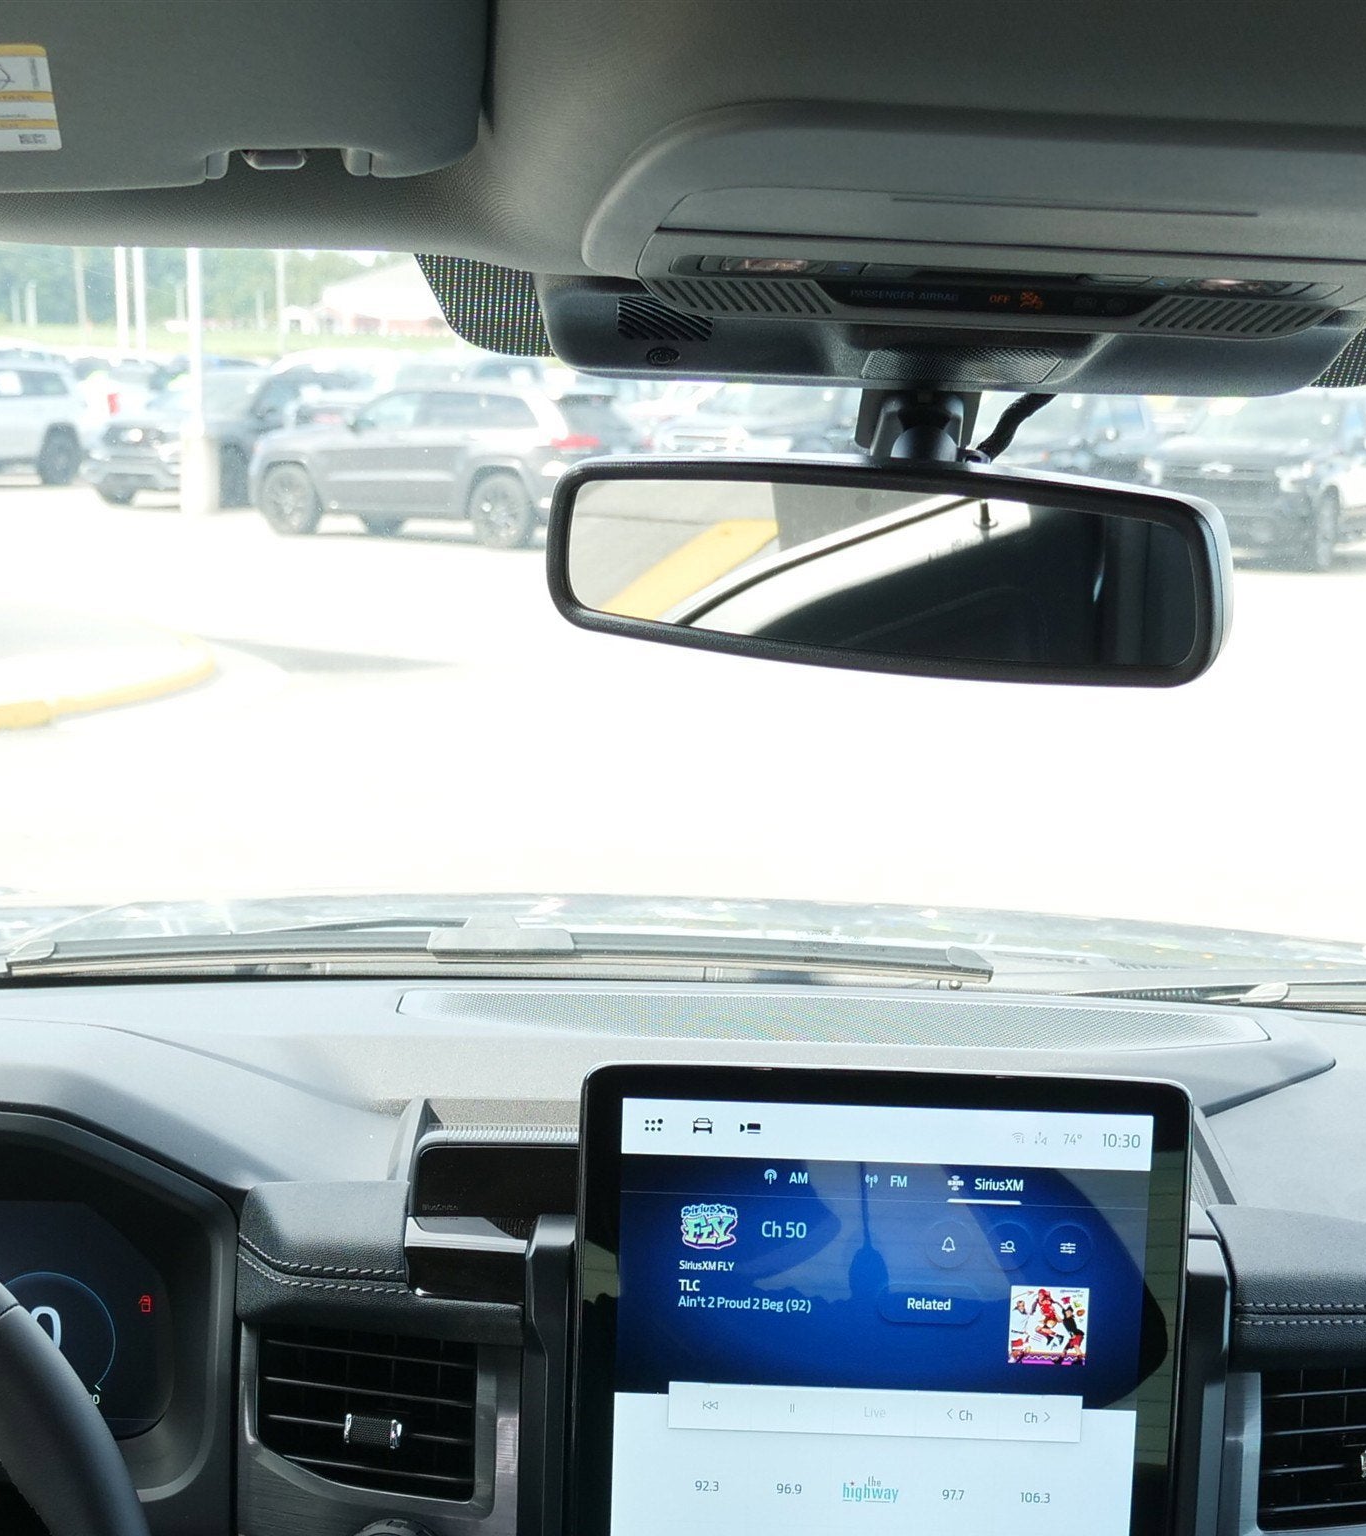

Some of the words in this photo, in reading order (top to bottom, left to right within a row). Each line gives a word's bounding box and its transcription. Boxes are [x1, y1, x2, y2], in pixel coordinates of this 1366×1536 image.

[1102, 1133, 1141, 1148] 10:30
[789, 1172, 809, 1184] AM
[890, 1176, 907, 1188] FM
[974, 1178, 1024, 1192] SiriusXM
[761, 1221, 782, 1238] Ch
[785, 1222, 807, 1239] 50
[679, 1260, 716, 1271] SiriusXM
[717, 1261, 735, 1271] FLY
[678, 1279, 701, 1291] TLC
[677, 1295, 706, 1308] Ain't
[707, 1297, 715, 1308] 2
[717, 1297, 751, 1309] Proud
[752, 1298, 760, 1310] 2
[762, 1299, 784, 1312] Beg
[785, 1300, 812, 1314] (92)
[907, 1297, 952, 1311] Related
[864, 1406, 886, 1418] Live
[958, 1410, 973, 1421] Ch
[1024, 1412, 1038, 1423] Ch
[694, 1480, 719, 1492] 92.3
[776, 1483, 802, 1495] 96.9
[842, 1482, 899, 1503] highway
[941, 1489, 965, 1501] 97.7
[1020, 1492, 1051, 1504] 106.3
